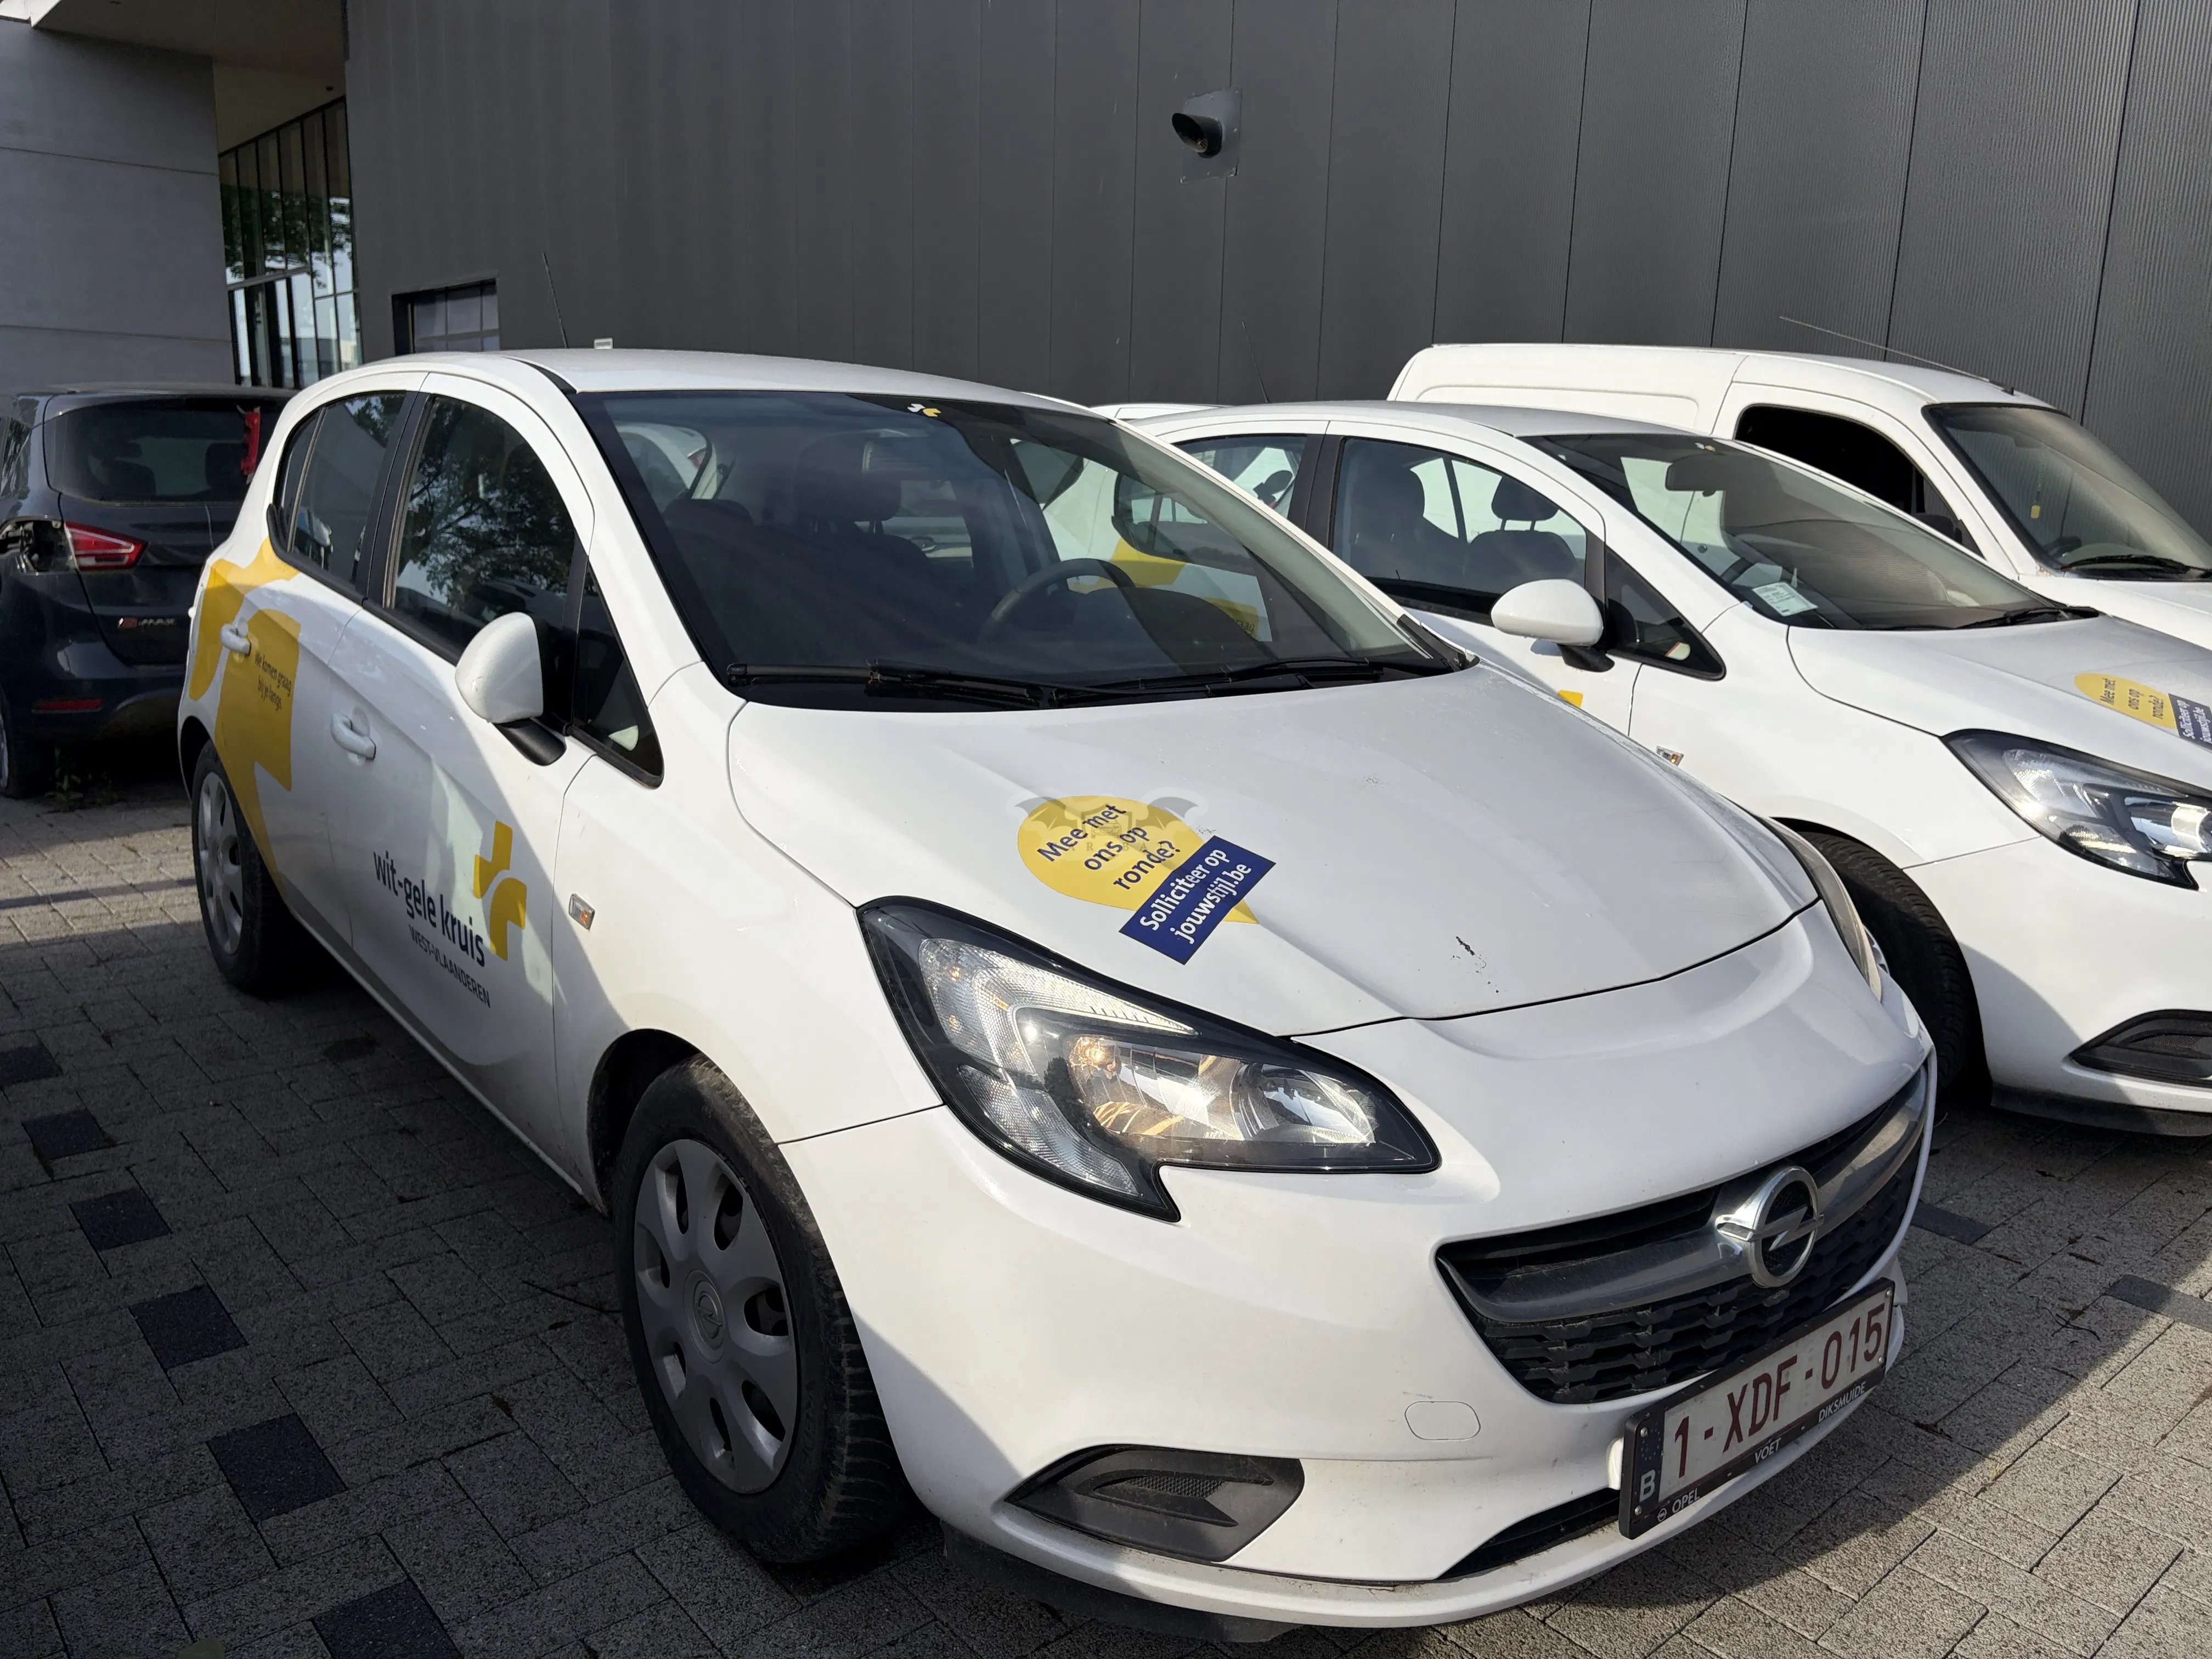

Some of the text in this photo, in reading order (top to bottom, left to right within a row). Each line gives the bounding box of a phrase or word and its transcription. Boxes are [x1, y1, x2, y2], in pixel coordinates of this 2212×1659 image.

[262, 653, 278, 680] komen
[277, 672, 292, 697] graag
[2100, 678, 2116, 706] Mee met
[2128, 689, 2145, 710] ons op
[2148, 695, 2164, 720] ronde?
[2176, 699, 2190, 709] op
[1037, 804, 1127, 862] Mee met
[1085, 827, 1150, 871] ons op
[1113, 840, 1181, 891] ronde?
[373, 850, 485, 967] wit-gele kruis
[1139, 849, 1229, 931] Solliciteer op
[1170, 863, 1252, 945] jouwstijl.be
[409, 924, 491, 1008] WEST-VLAANDEREN
[1672, 1381, 1866, 1513] OPEL VOET DIKSMUIDE
[1639, 1469, 1656, 1503] B
